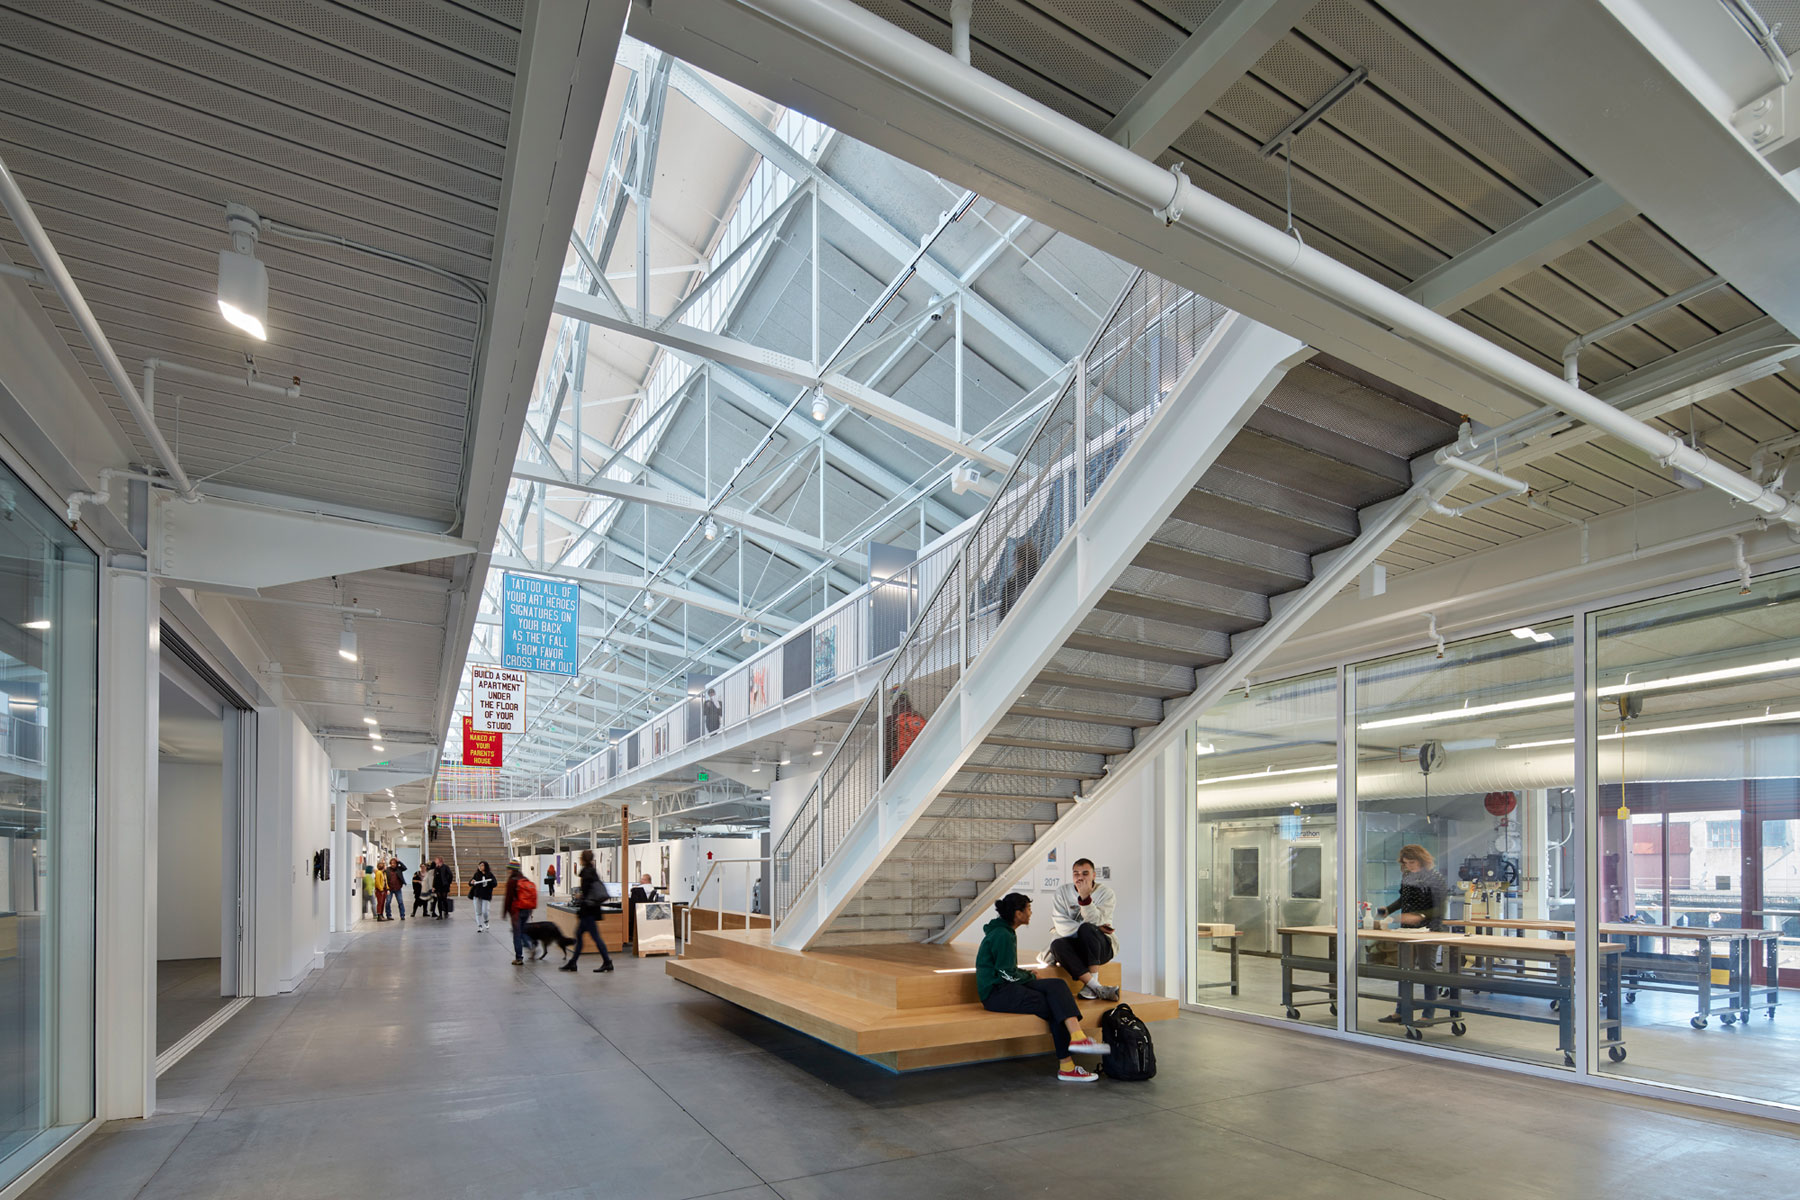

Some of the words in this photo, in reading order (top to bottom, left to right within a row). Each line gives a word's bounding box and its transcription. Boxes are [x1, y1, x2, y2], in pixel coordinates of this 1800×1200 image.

[511, 578, 541, 593] TATTOO
[543, 584, 559, 596] ALL
[562, 586, 573, 598] OF
[506, 590, 527, 604] YOUR
[528, 594, 544, 606] ART
[546, 597, 576, 611] HEROES
[510, 603, 559, 621] SIGNATURES
[561, 611, 572, 623] ON
[518, 618, 539, 631] YOUR
[541, 622, 562, 634] BACK
[512, 629, 523, 641] AS
[525, 631, 546, 644] THEY
[549, 635, 569, 648] FALL
[516, 643, 538, 656] FROM
[505, 654, 533, 668] CROSS
[535, 658, 556, 671] THEM
[558, 661, 574, 673] OUT
[474, 669, 494, 680] BUILD
[495, 672, 501, 680] A
[501, 672, 525, 683] SMALL
[478, 681, 520, 692] APARTMENT
[488, 691, 511, 701] UNDER
[480, 700, 494, 709] THE
[496, 701, 519, 711] FLOOR
[484, 710, 494, 718] OF
[496, 711, 514, 720] YOUR
[486, 721, 512, 731] STUDIO
[469, 733, 488, 742] NAKED
[475, 742, 491, 750] YOUR
[470, 749, 495, 757] PARENTS
[1044, 877, 1060, 887] 2017
